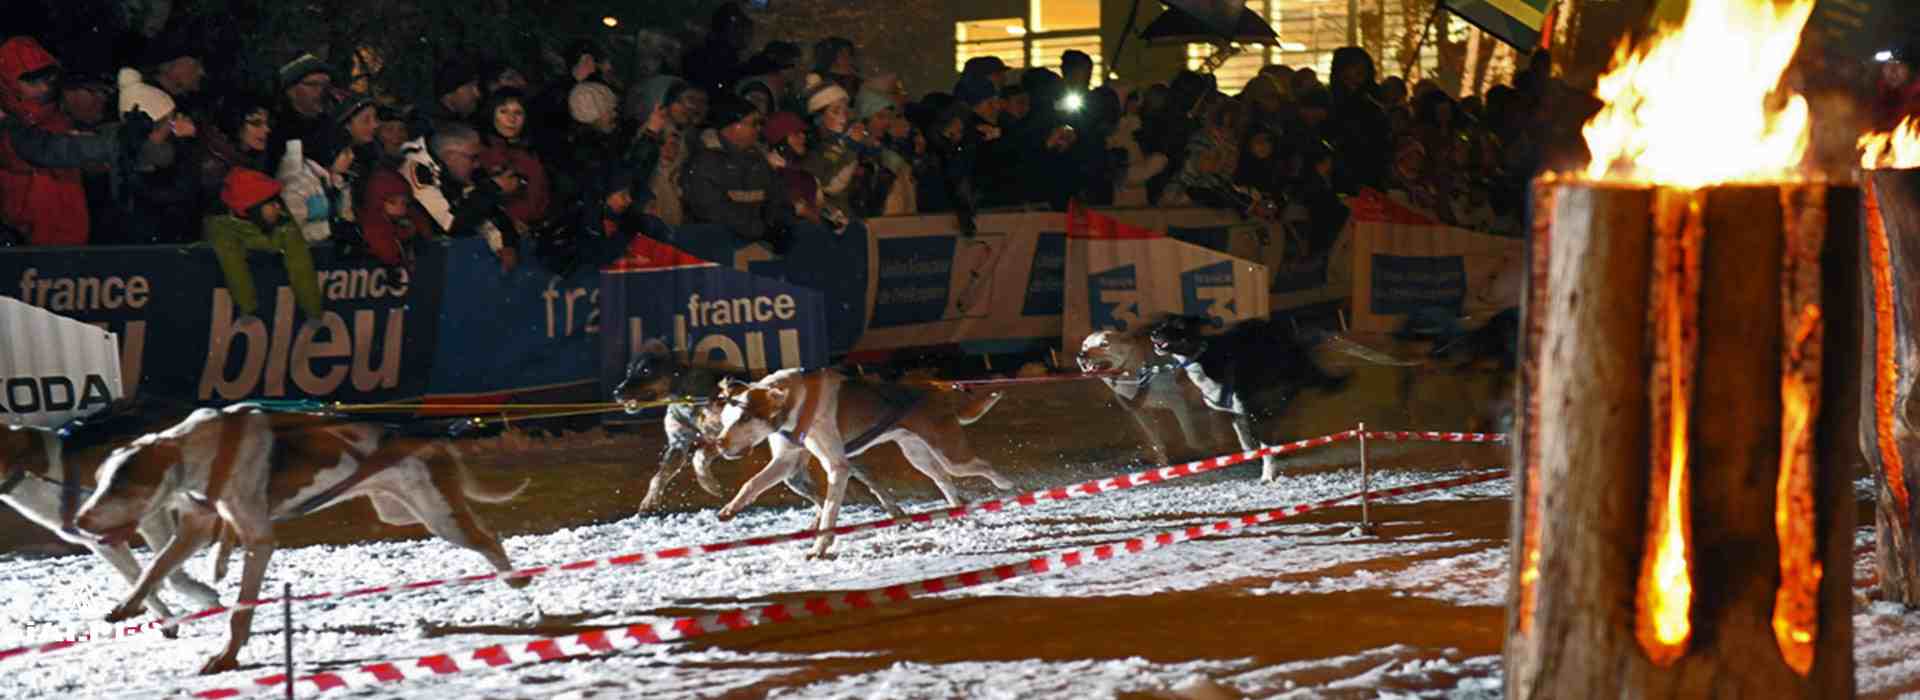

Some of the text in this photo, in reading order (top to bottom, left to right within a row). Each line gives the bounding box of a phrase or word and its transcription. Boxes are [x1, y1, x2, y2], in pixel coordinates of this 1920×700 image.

[20, 267, 149, 311] france
[317, 266, 409, 300] rance
[688, 290, 797, 328] france
[1100, 287, 1235, 335] 3 3
[198, 286, 405, 401] bleu
[0, 373, 113, 413] ODA
